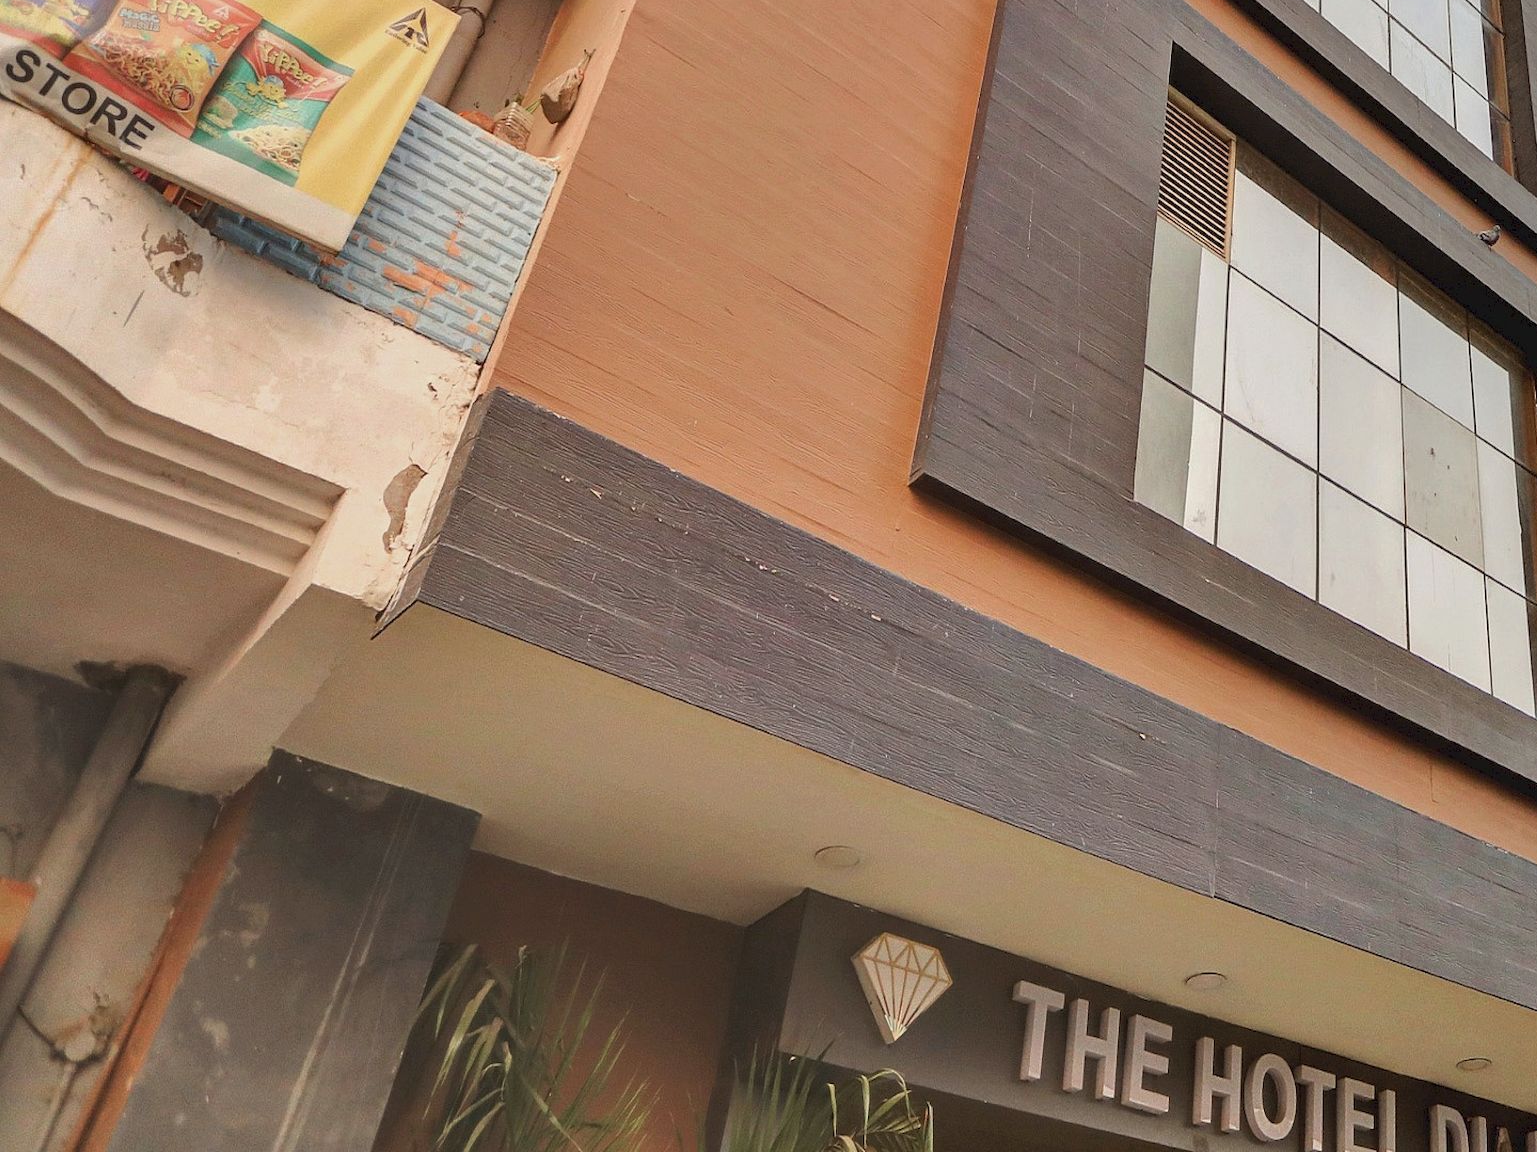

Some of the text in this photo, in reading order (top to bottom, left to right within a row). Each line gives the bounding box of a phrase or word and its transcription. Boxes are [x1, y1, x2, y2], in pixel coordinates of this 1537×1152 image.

[5, 49, 156, 151] STORE
[1013, 980, 1397, 1152] THE HOTEL
